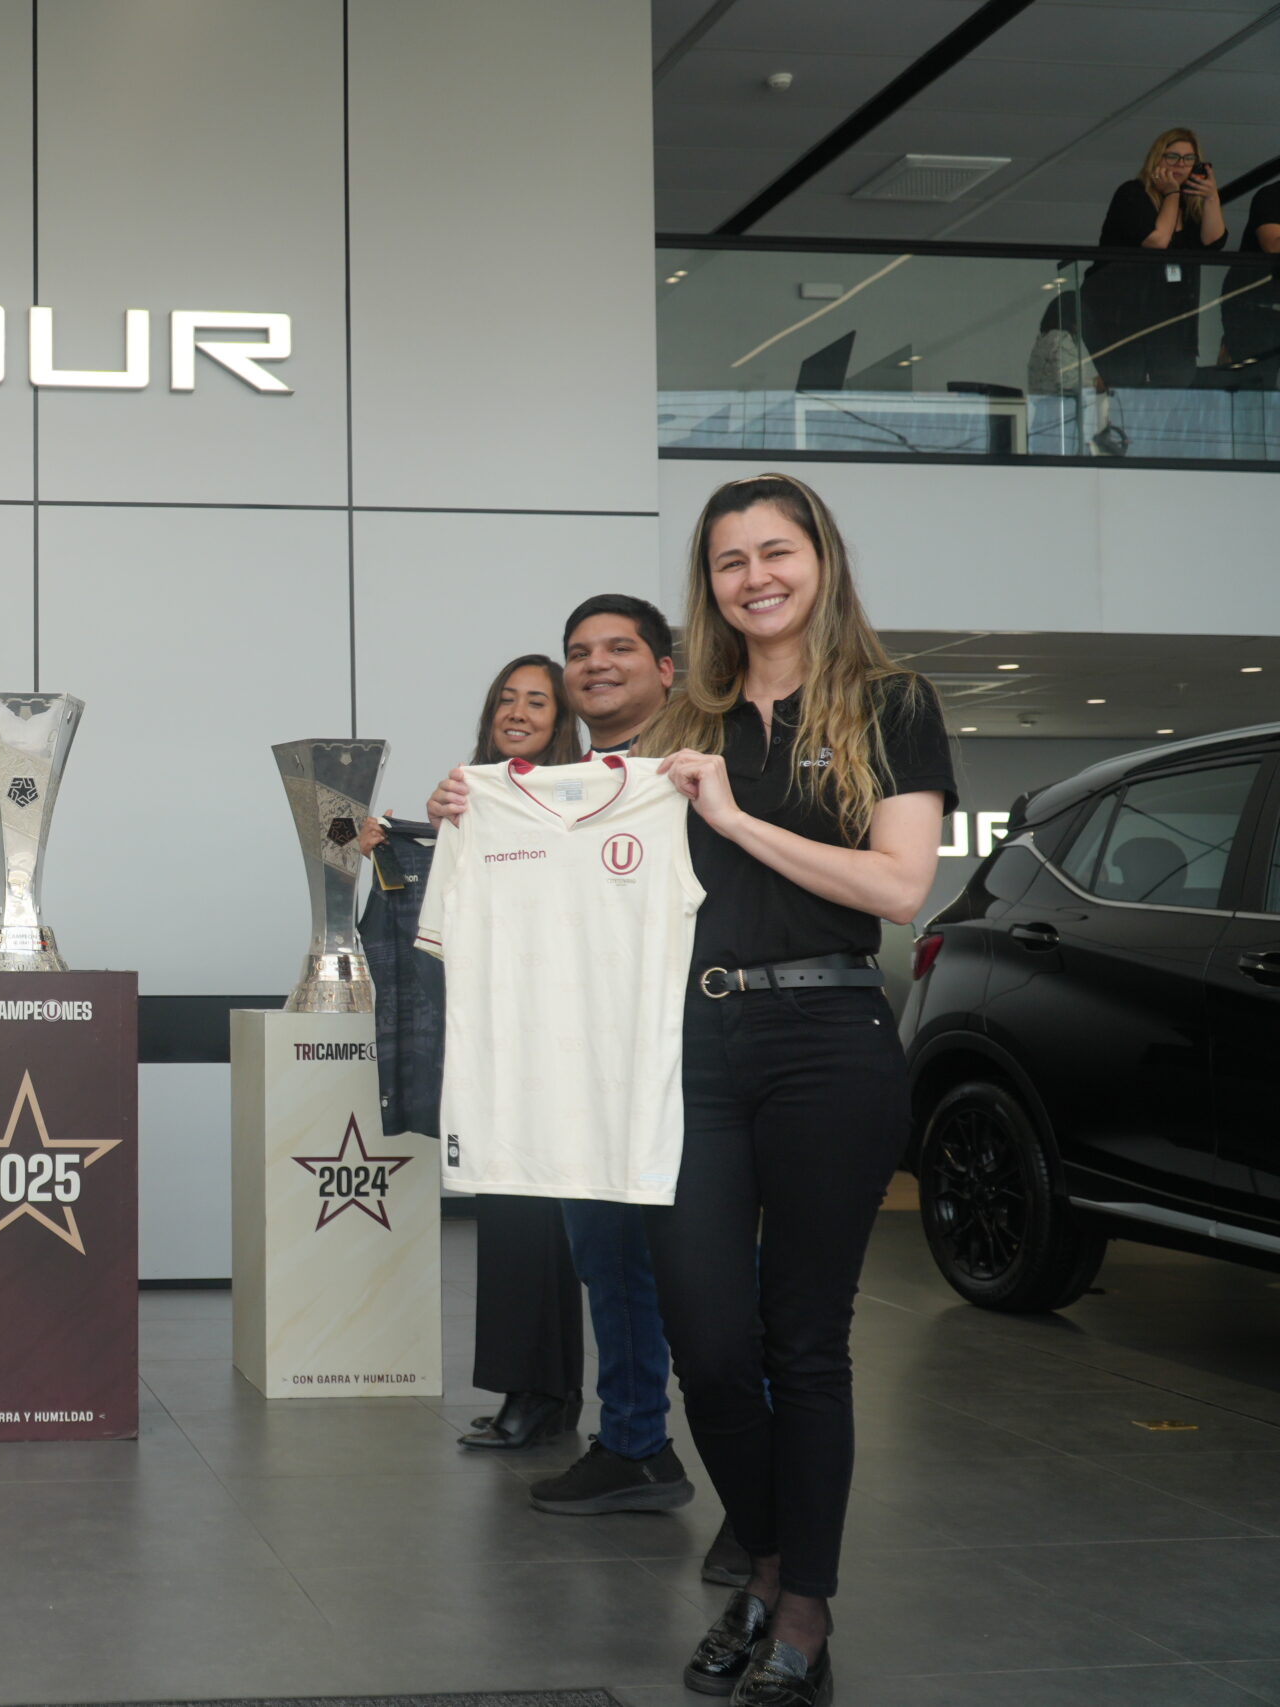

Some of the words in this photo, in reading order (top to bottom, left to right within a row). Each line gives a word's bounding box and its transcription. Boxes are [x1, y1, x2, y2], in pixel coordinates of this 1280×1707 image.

[484, 850, 547, 863] marathon
[318, 1166, 389, 1198] 2024
[292, 1375, 314, 1385] CON
[317, 1374, 351, 1384] GARRA
[353, 1374, 361, 1384] Y
[363, 1373, 417, 1384] HUMILDAD
[23, 1411, 32, 1423] Y
[34, 1410, 94, 1423] HUMILDAD
